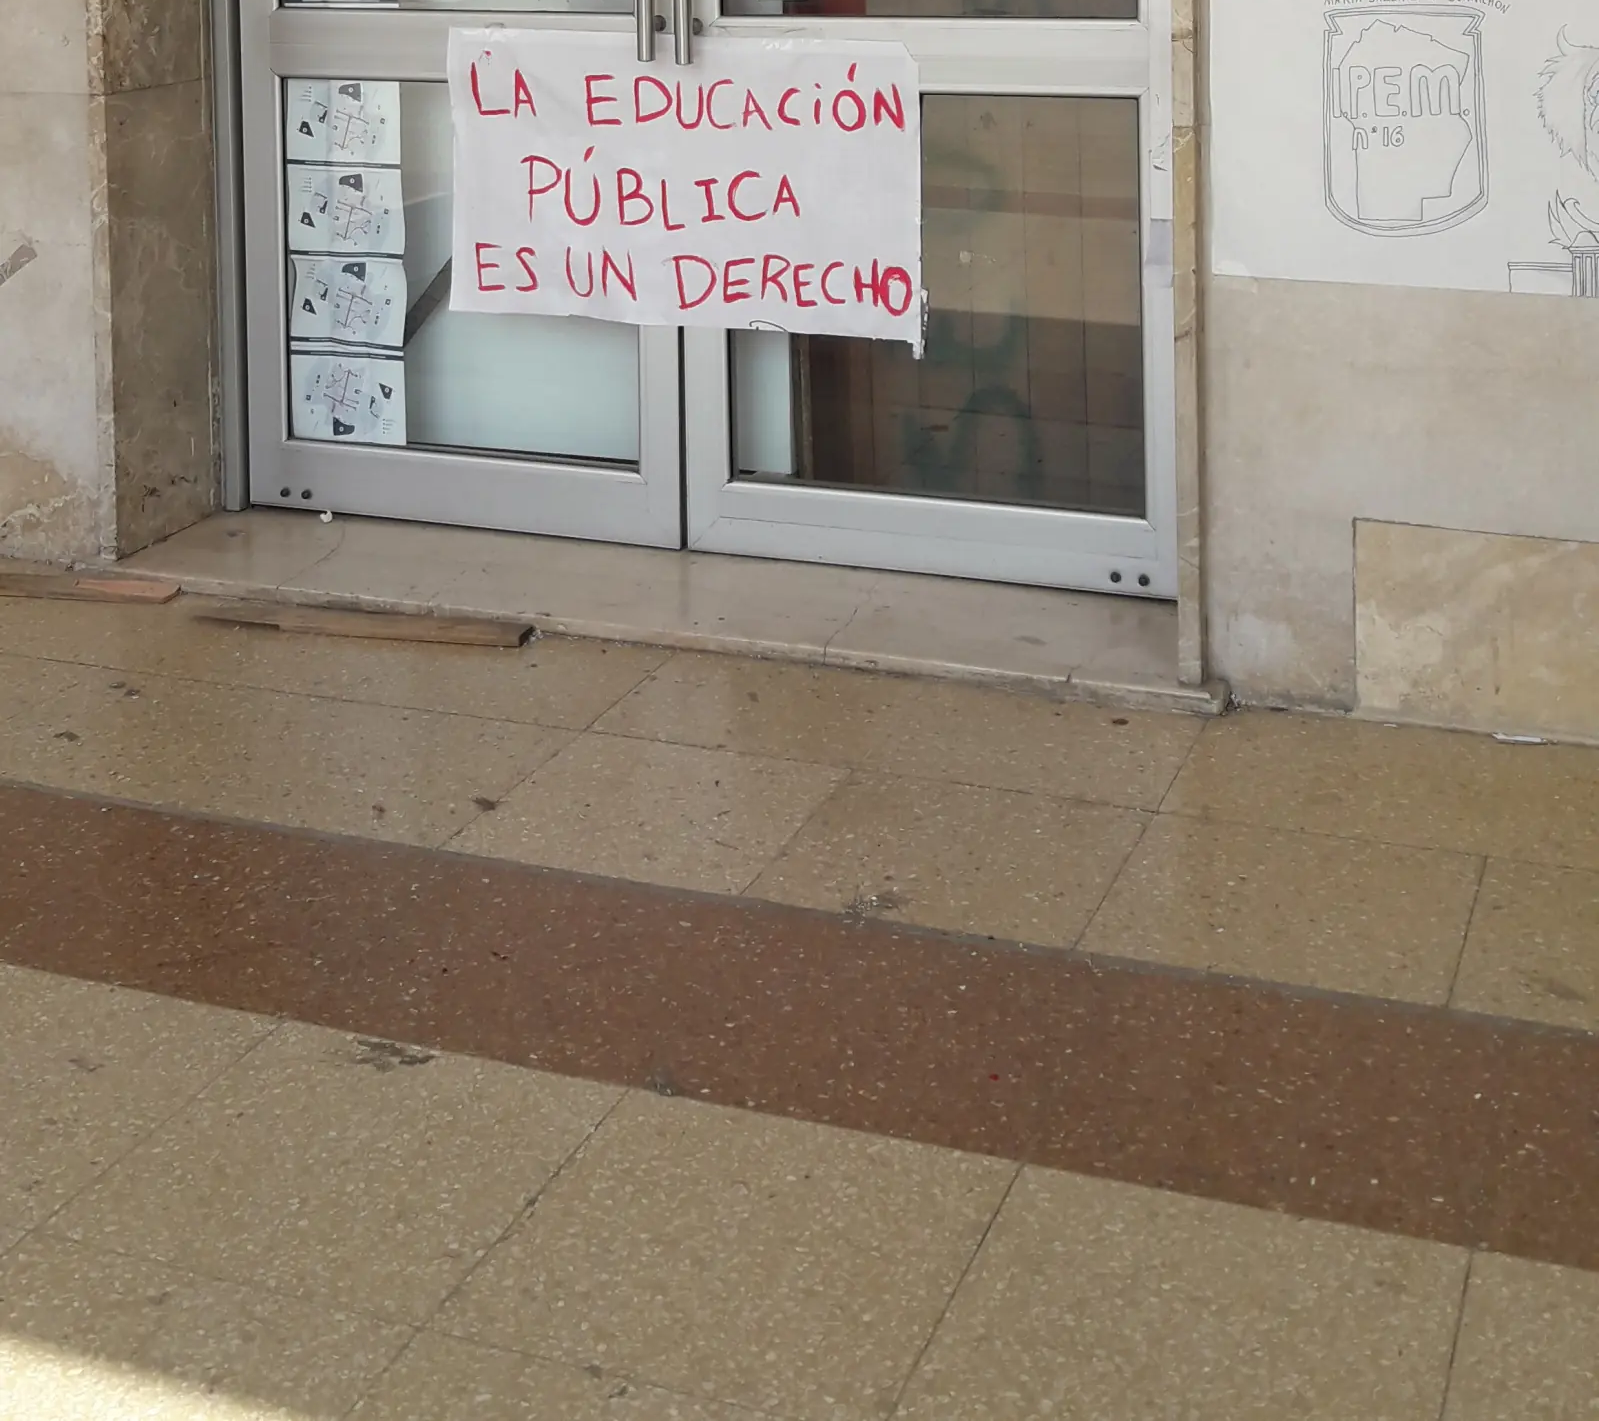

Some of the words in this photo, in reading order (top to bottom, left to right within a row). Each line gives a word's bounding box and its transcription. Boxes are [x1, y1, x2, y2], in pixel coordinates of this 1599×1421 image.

[470, 62, 537, 118] LA
[520, 145, 801, 231] PÚBLICA
[475, 242, 538, 292] ES
[565, 246, 637, 303] UN
[671, 253, 914, 317] DERECHO
